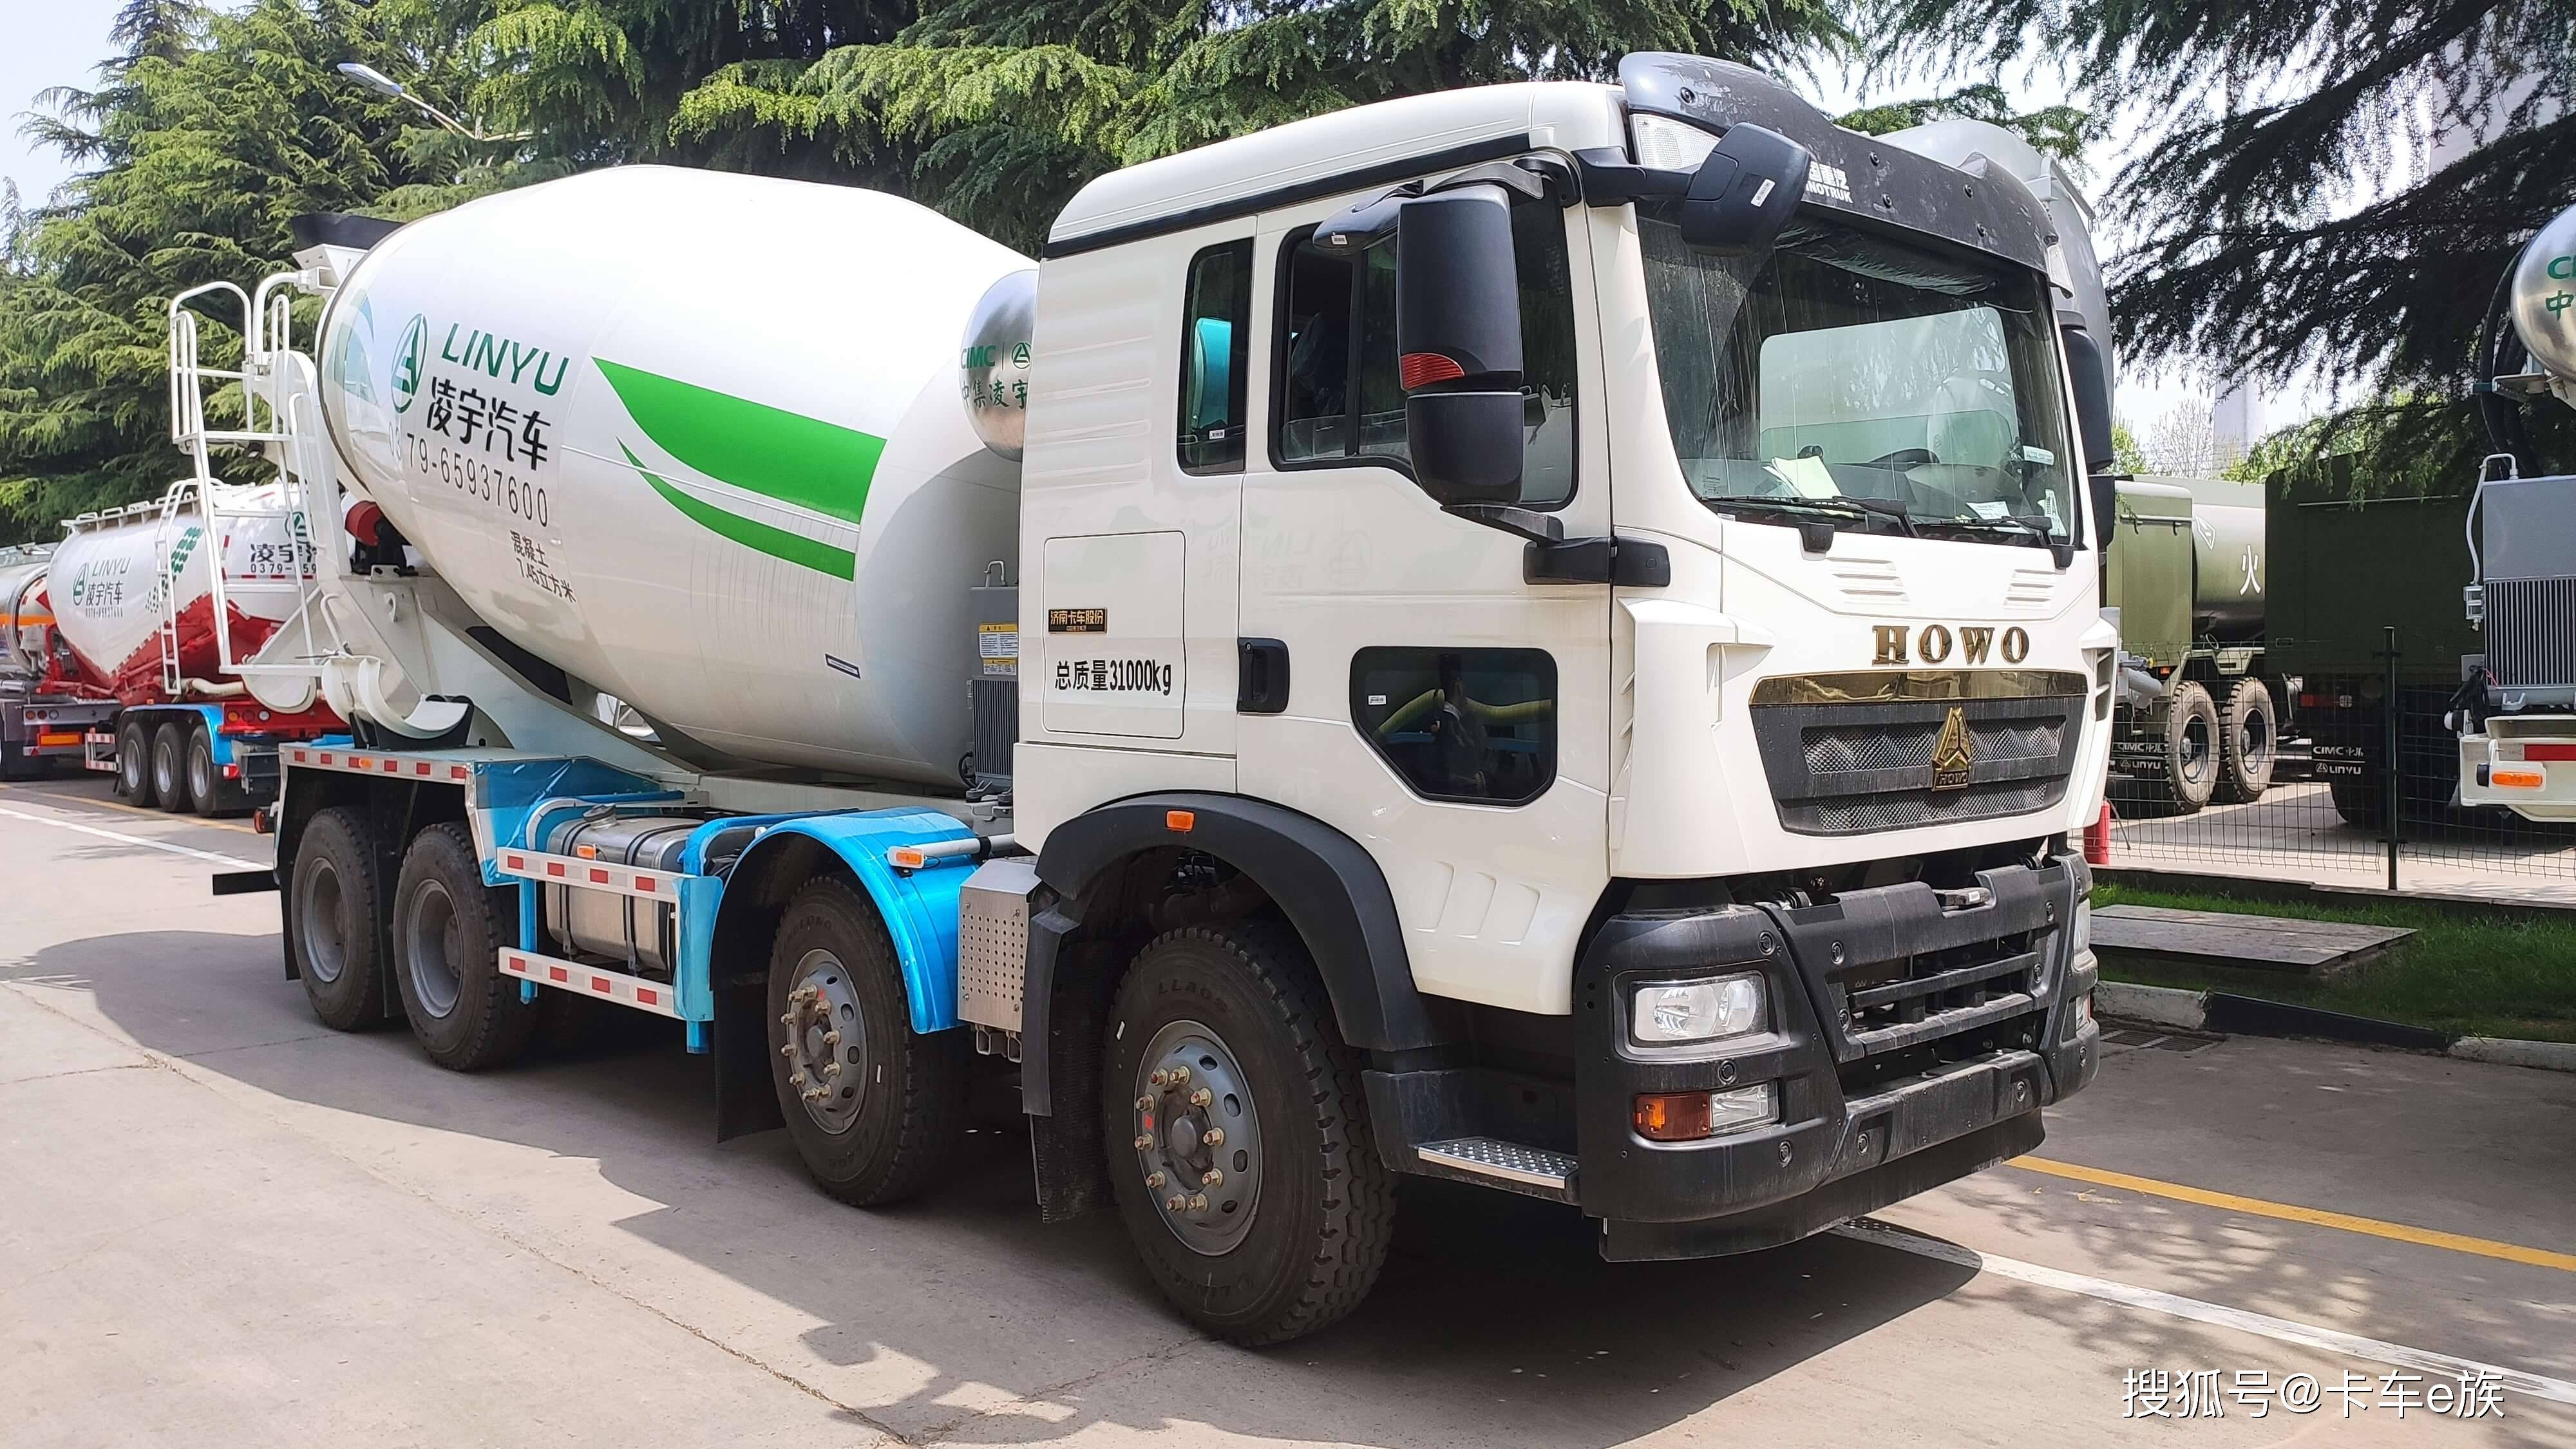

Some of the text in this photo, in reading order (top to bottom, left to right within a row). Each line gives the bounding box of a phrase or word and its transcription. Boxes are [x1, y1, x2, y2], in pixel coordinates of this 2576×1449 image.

[2546, 290, 2576, 321] 中
[441, 323, 569, 396] LINYU
[961, 345, 996, 369] CIMC
[426, 376, 551, 470] 凌宇汽车
[510, 529, 549, 567] 混凝土
[92, 557, 131, 576] LINYU
[251, 564, 316, 574] 0379-59
[2240, 545, 2261, 596] 火
[1050, 609, 1103, 625] 济南卡车股份
[1872, 624, 2030, 665] HOWO
[1055, 659, 1171, 696] 总质量31000kg
[2313, 746, 2345, 755] CIMC
[1939, 772, 1968, 785] HOWO
